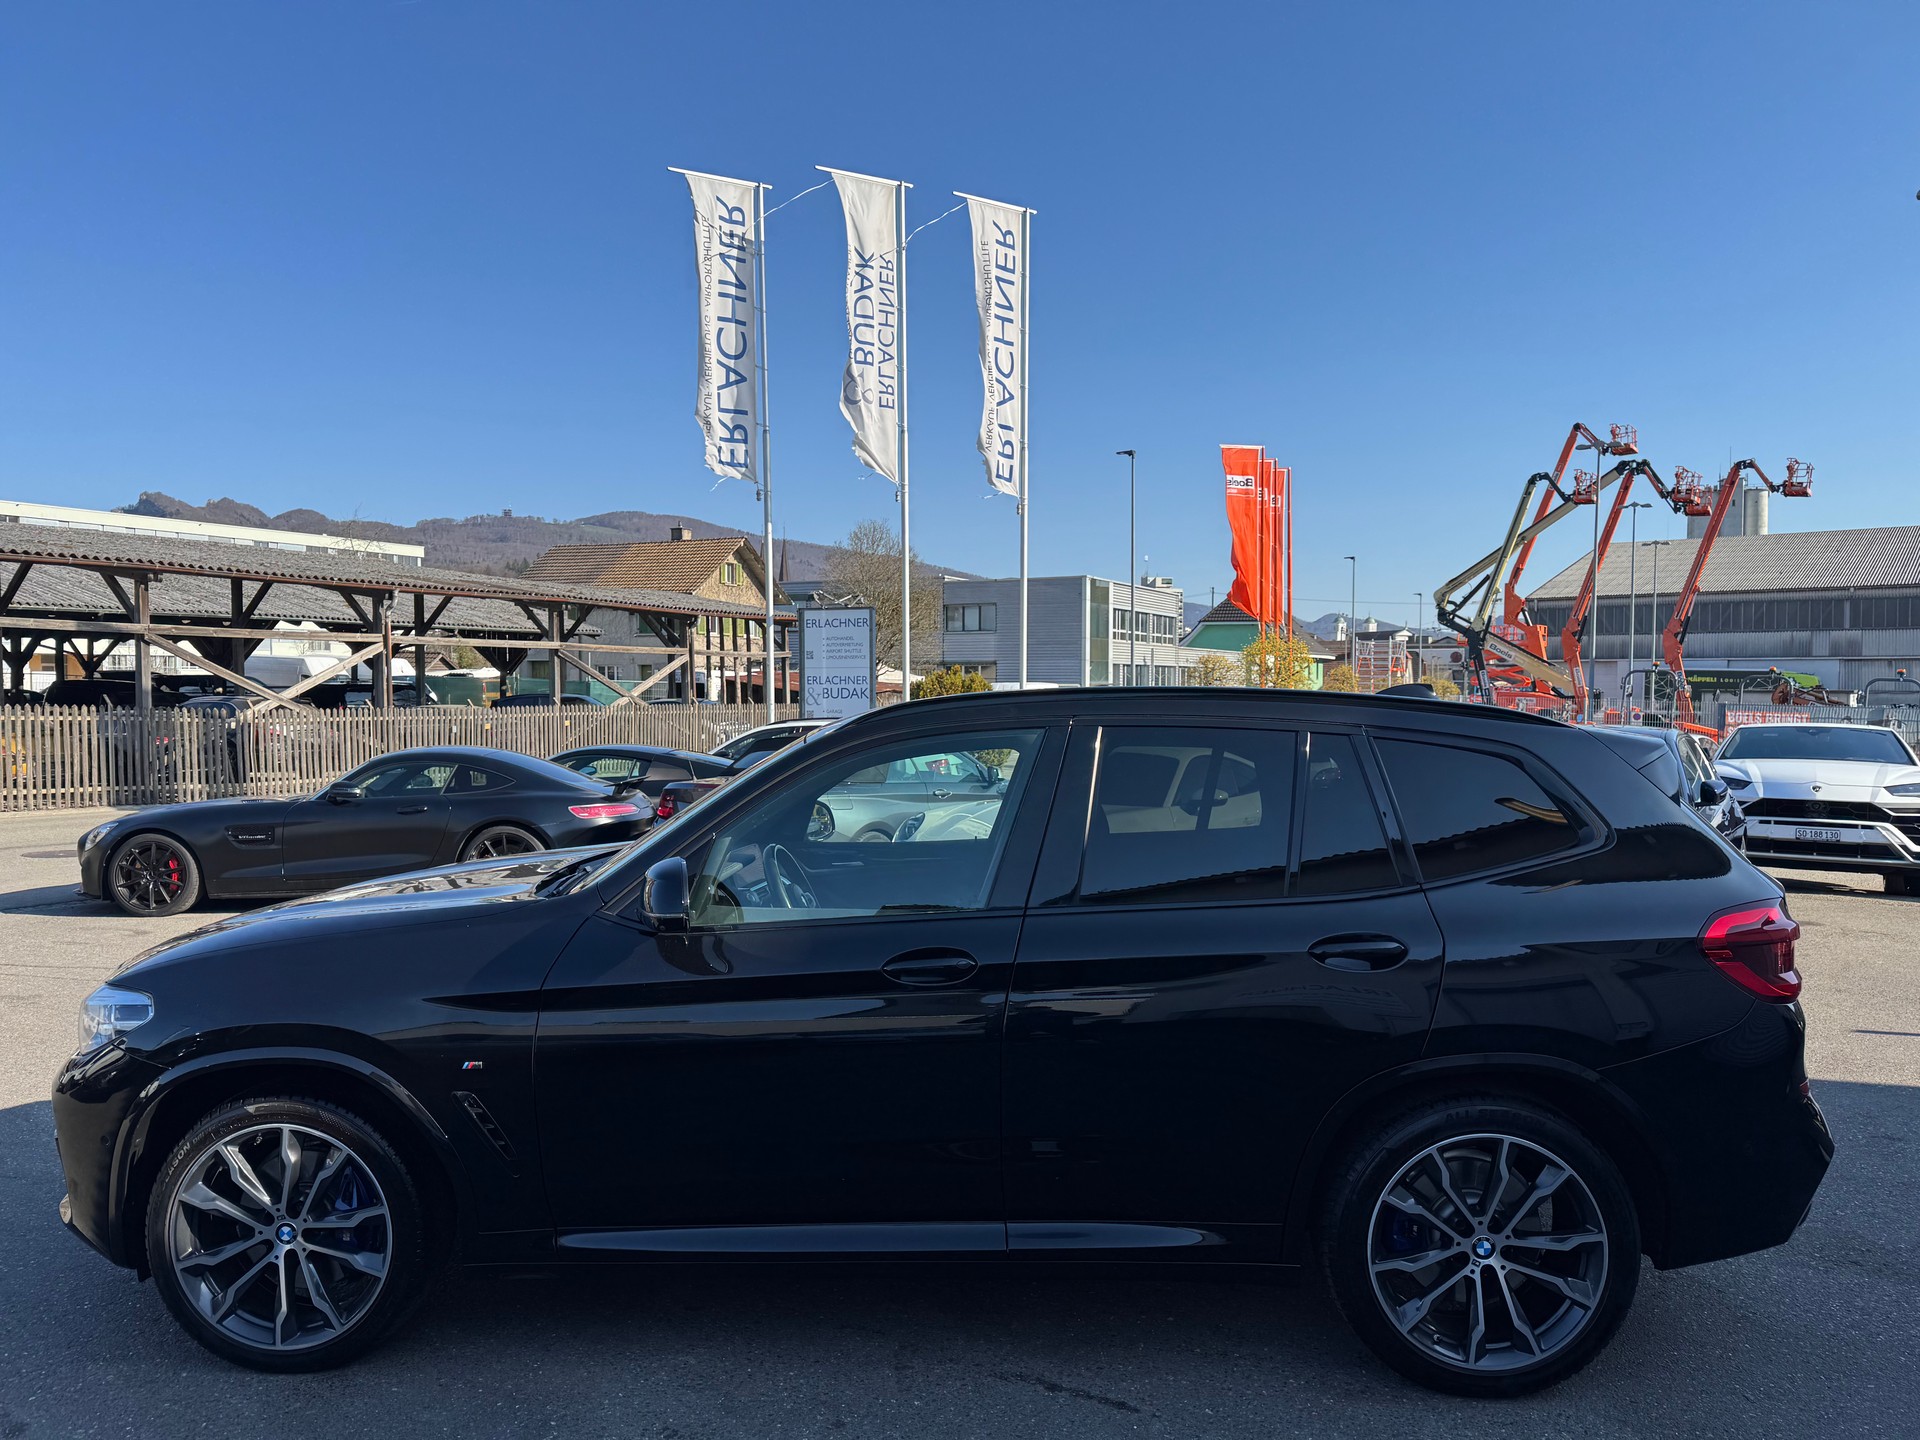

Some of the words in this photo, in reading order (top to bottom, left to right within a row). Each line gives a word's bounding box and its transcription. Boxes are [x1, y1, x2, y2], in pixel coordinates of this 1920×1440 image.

[805, 617, 869, 629] ERLACHNER
[806, 675, 869, 686] ERLACHNER
[805, 686, 822, 706] &
[822, 687, 869, 700] BUDAK
[1727, 711, 1762, 724] BOELS
